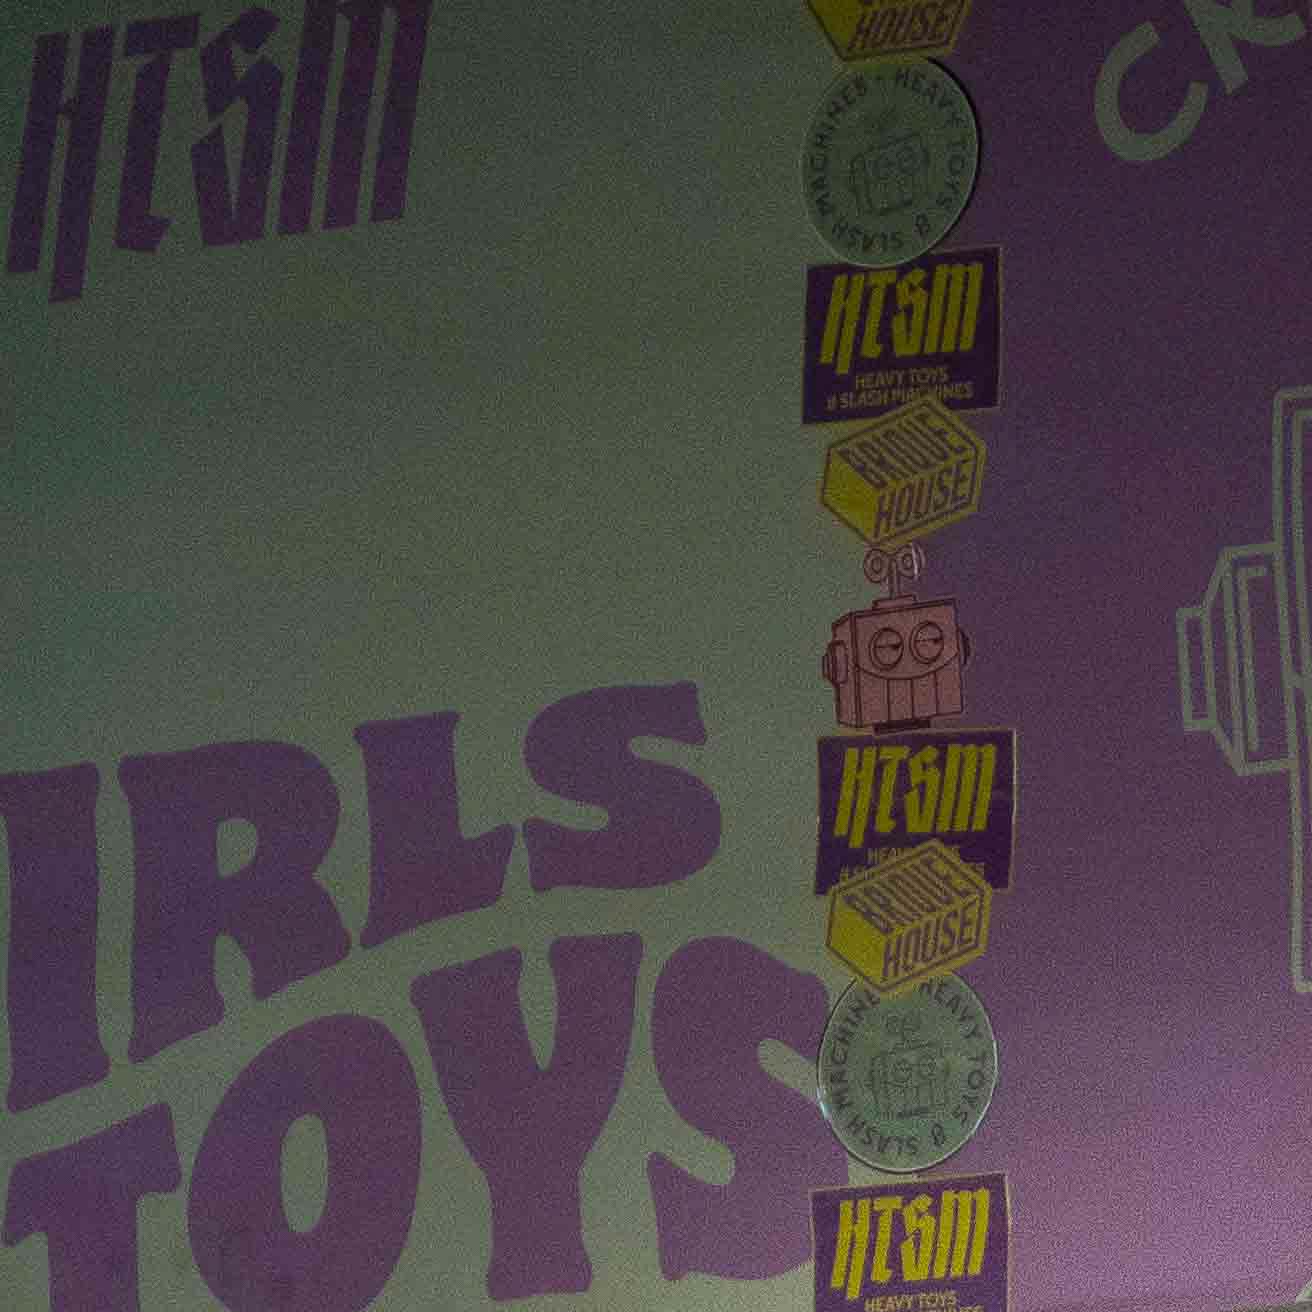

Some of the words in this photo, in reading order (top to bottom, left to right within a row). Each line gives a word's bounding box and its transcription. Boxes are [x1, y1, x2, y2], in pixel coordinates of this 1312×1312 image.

[819, 262, 984, 376] HTSM
[839, 390, 888, 410] SLASH
[854, 370, 904, 392] HEAVY
[907, 364, 949, 386] TOYS
[874, 456, 971, 538] HOUSE
[833, 743, 997, 848] HTSM
[880, 898, 980, 982] HOUSE
[919, 979, 984, 1040] HEAVY
[952, 1051, 987, 1124] TOYS
[847, 1113, 919, 1157] SLASH
[830, 1187, 991, 1301] HTSM
[918, 1290, 958, 1308] TOYS
